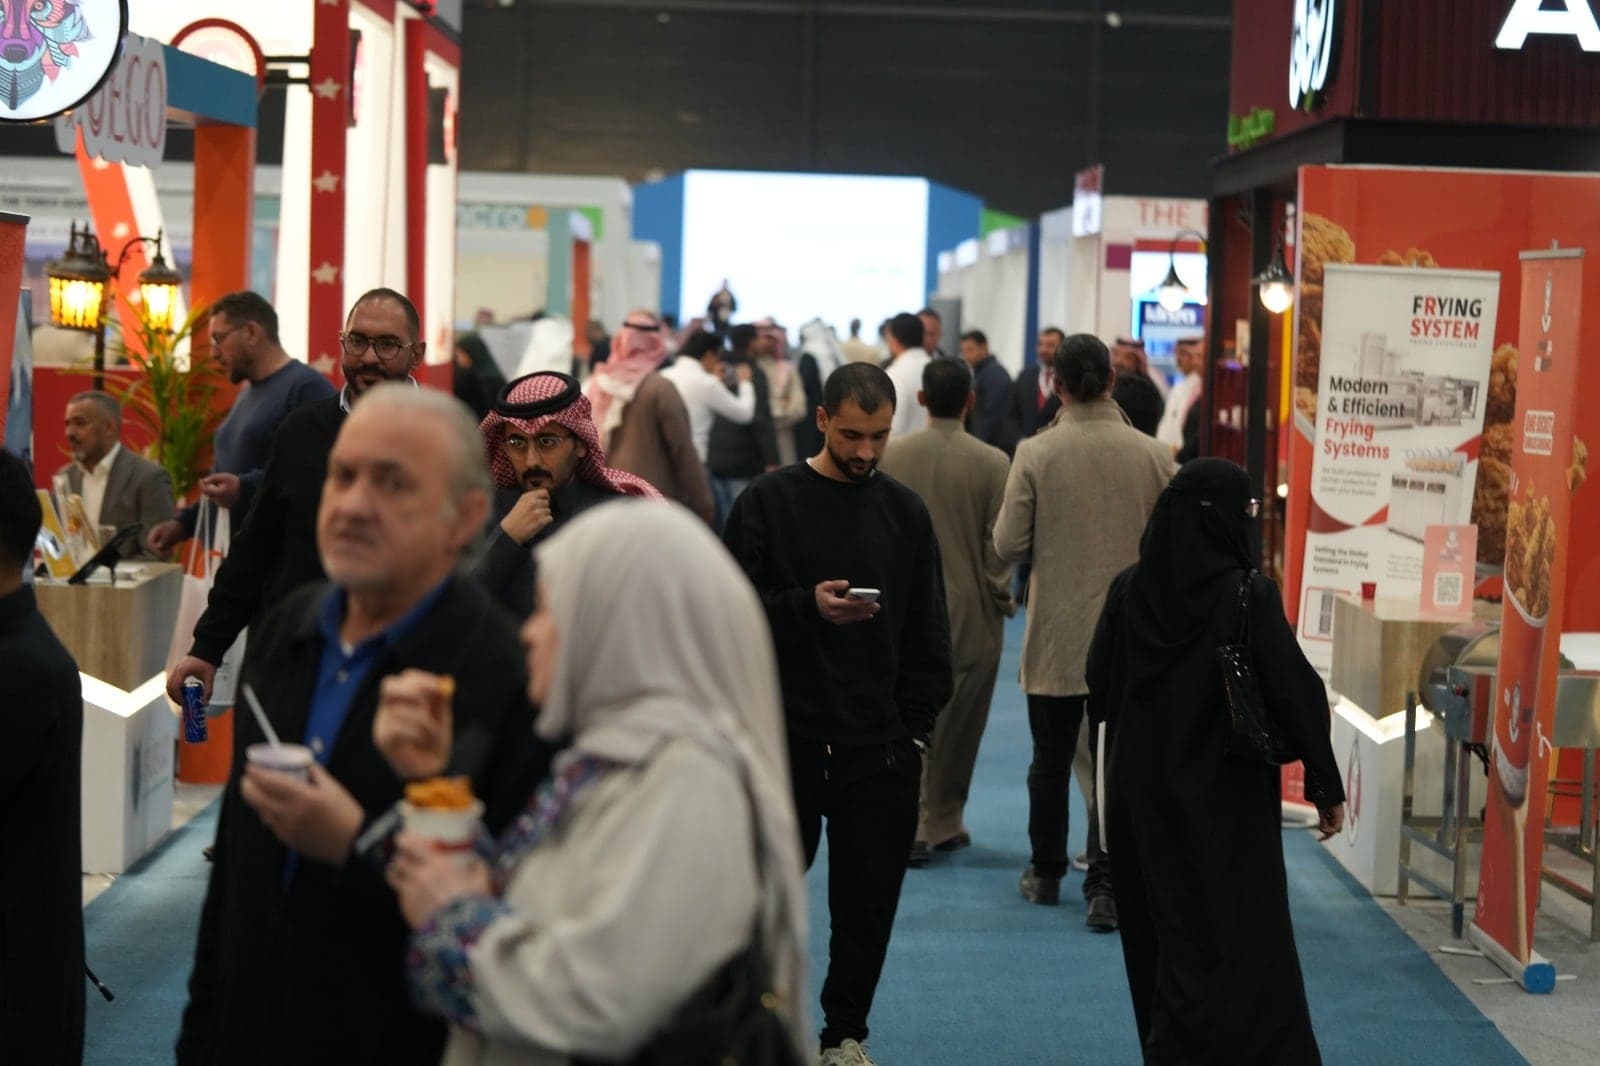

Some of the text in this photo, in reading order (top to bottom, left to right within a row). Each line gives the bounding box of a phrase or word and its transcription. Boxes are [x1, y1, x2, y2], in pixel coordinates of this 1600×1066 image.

[1138, 201, 1191, 227] THE
[1413, 296, 1482, 318] FRYING
[1411, 318, 1479, 340] SYSTEM
[1329, 376, 1388, 395] Modern
[1328, 398, 1404, 417] & Efficient
[1325, 417, 1374, 441] Frying
[1324, 438, 1389, 460] Systems
